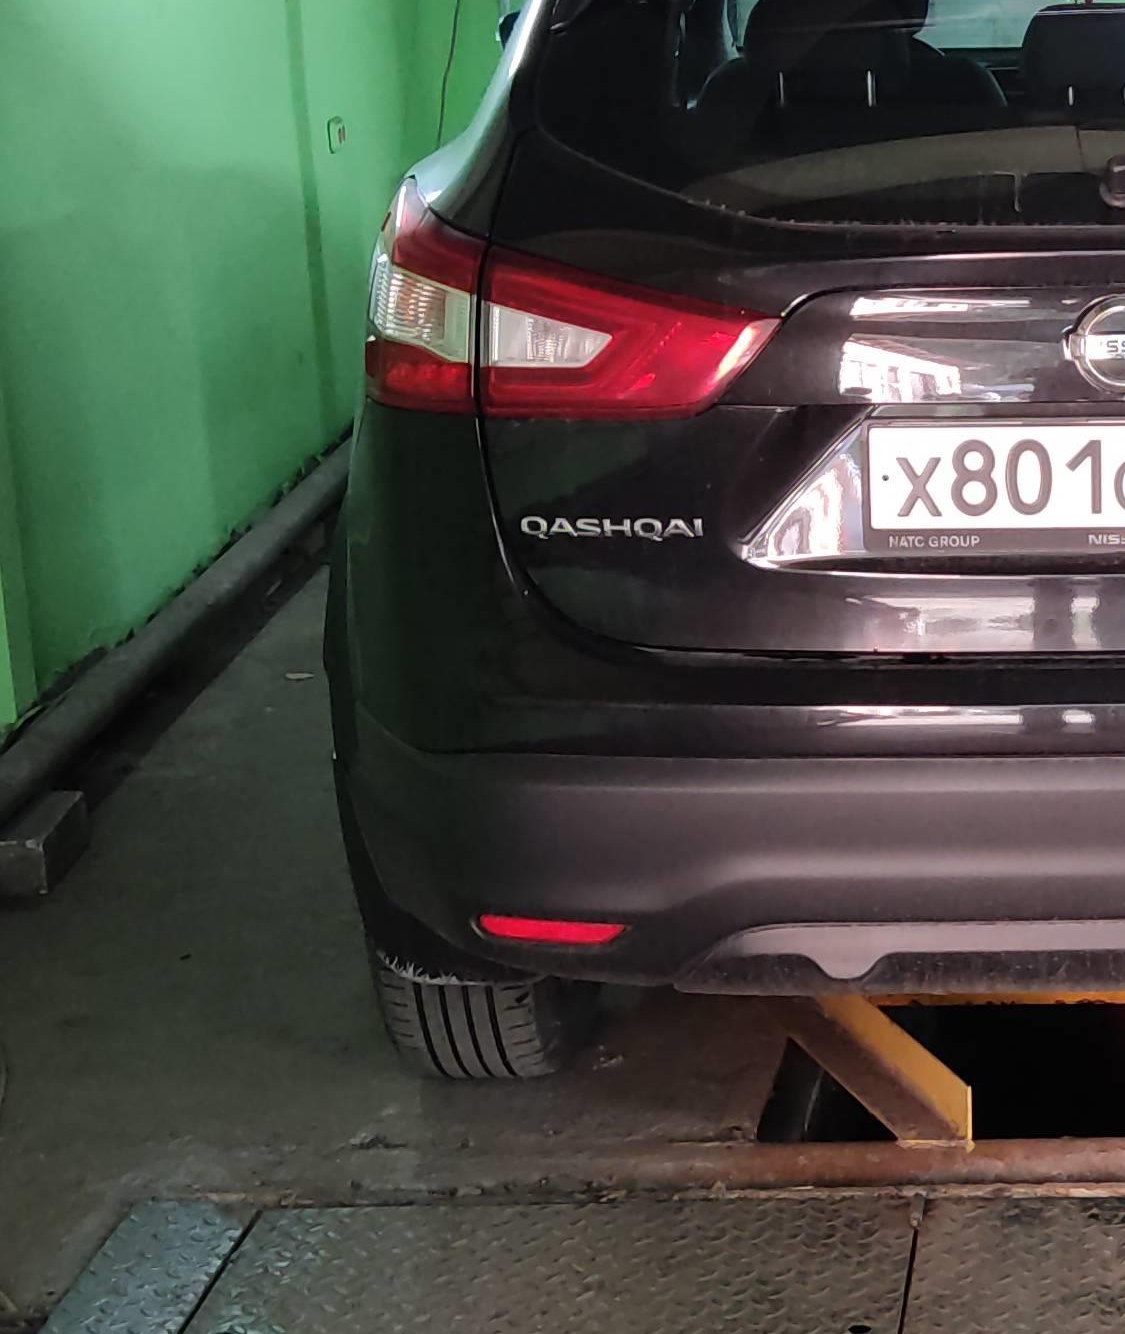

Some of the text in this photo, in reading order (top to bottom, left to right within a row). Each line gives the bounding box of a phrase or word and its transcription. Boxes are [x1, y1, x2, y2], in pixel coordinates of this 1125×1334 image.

[520, 515, 704, 542] QASHQAI
[888, 534, 981, 549] NATC GROUP
